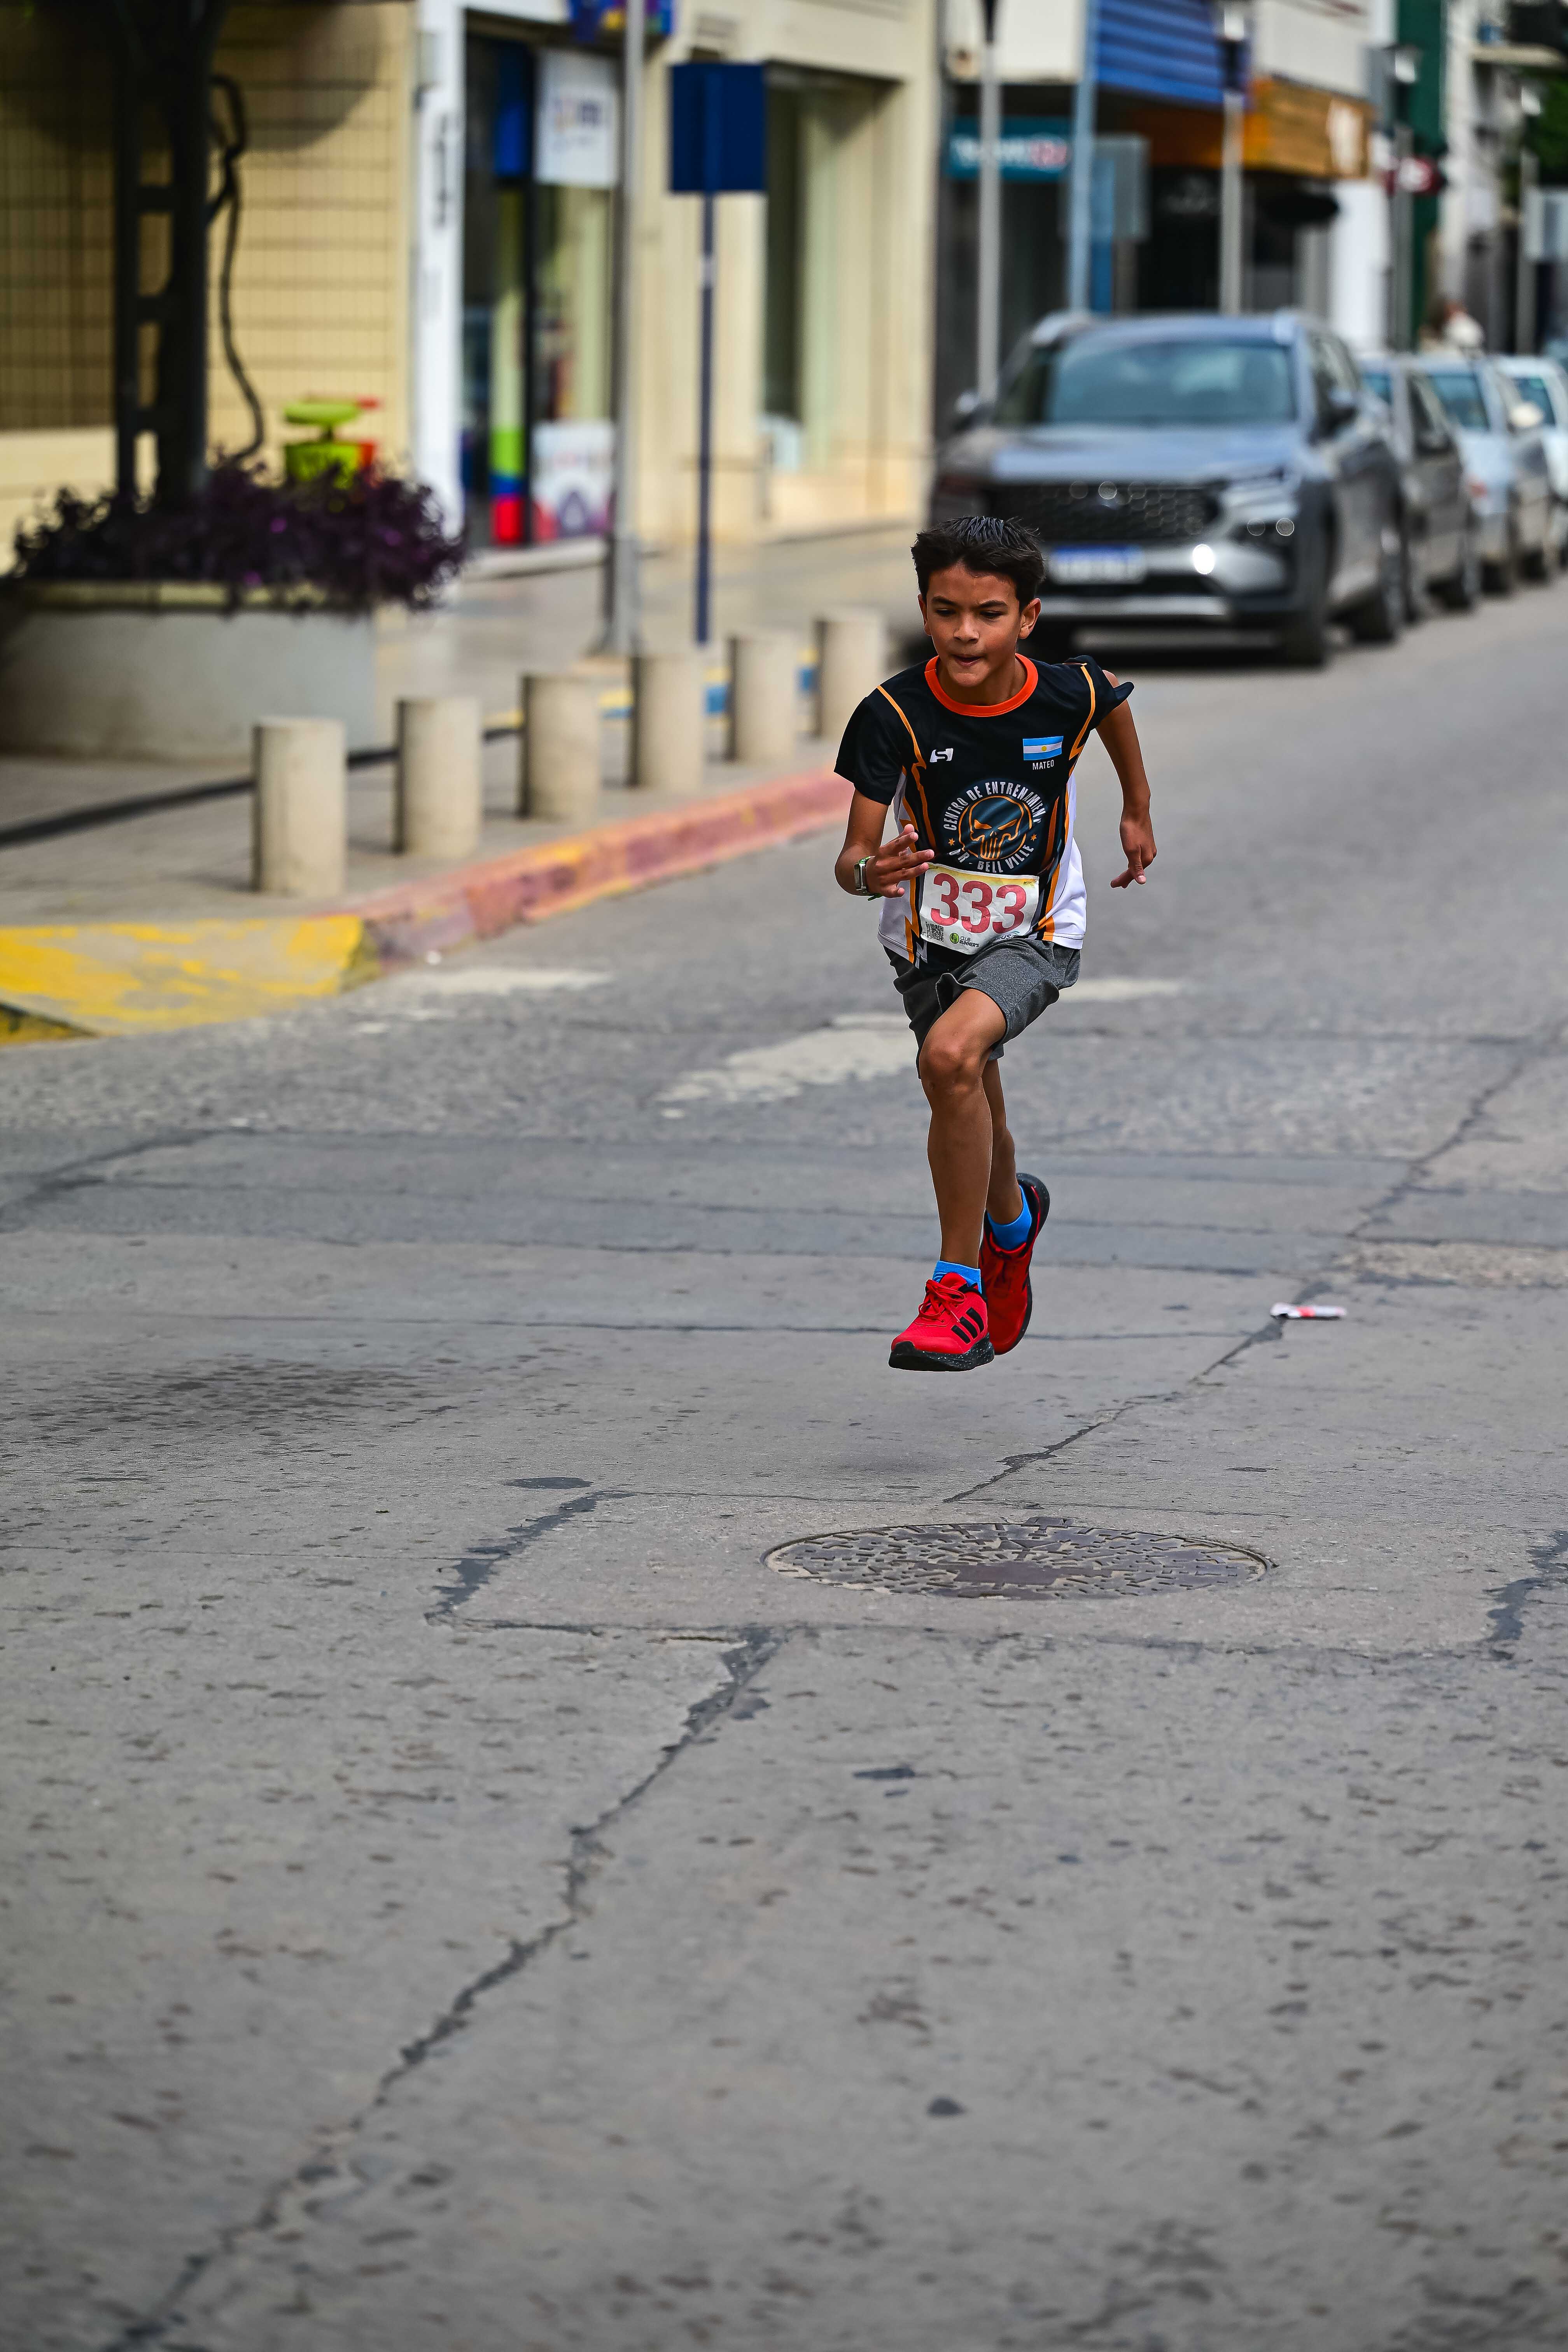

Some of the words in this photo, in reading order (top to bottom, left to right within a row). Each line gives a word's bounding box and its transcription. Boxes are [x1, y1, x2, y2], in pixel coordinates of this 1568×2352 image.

[1032, 760, 1054, 770] MATEO
[943, 798, 968, 830] CENTRO
[966, 786, 983, 801] DE
[977, 861, 1003, 873] BELL
[1009, 845, 1034, 869] VILLE
[931, 872, 1027, 934] 333
